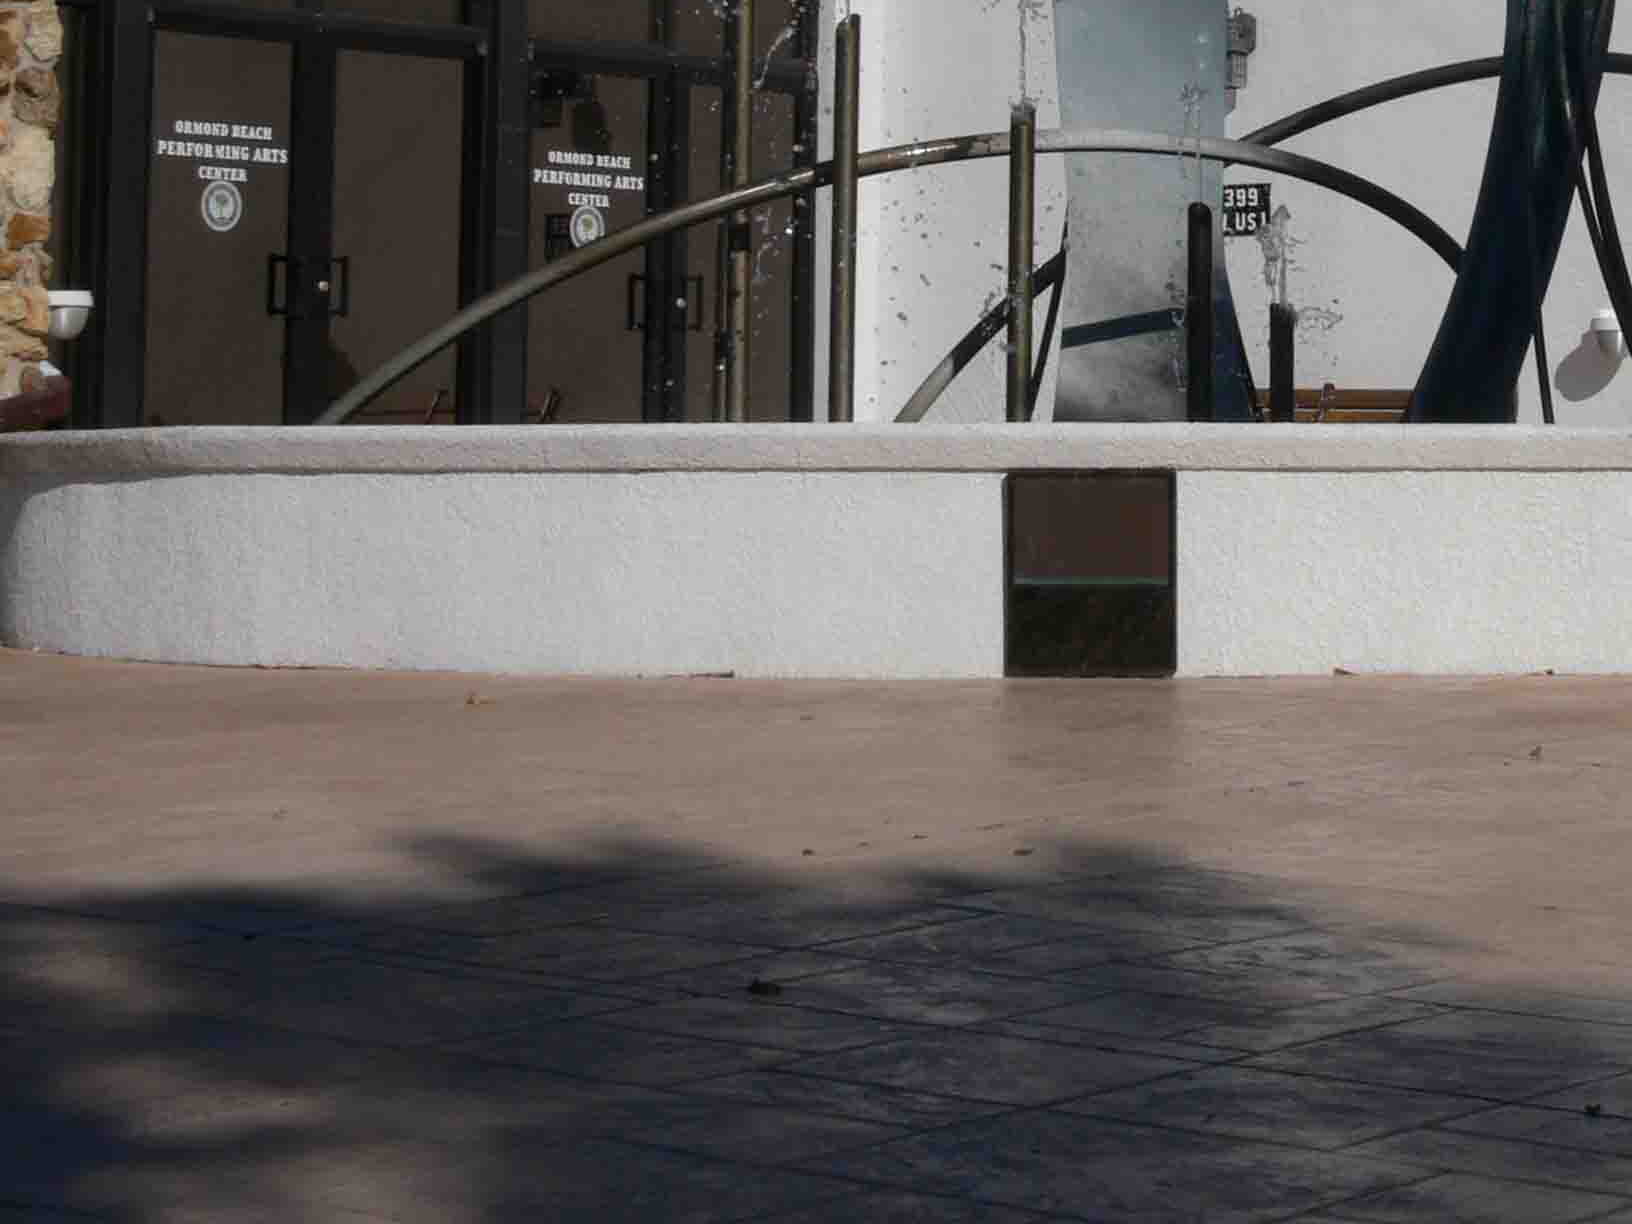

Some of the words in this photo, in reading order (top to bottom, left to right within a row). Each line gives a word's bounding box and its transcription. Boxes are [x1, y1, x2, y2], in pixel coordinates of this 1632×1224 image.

[175, 120, 228, 136] ORMOND
[157, 140, 248, 160] PERFORMING
[252, 147, 288, 163] ARTS
[198, 166, 247, 181] CENTER
[533, 168, 611, 187] PERFORMING
[613, 176, 644, 189] ARTS
[568, 193, 609, 206] CENTER
[1224, 188, 1258, 207] 399
[1235, 212, 1257, 231] US
